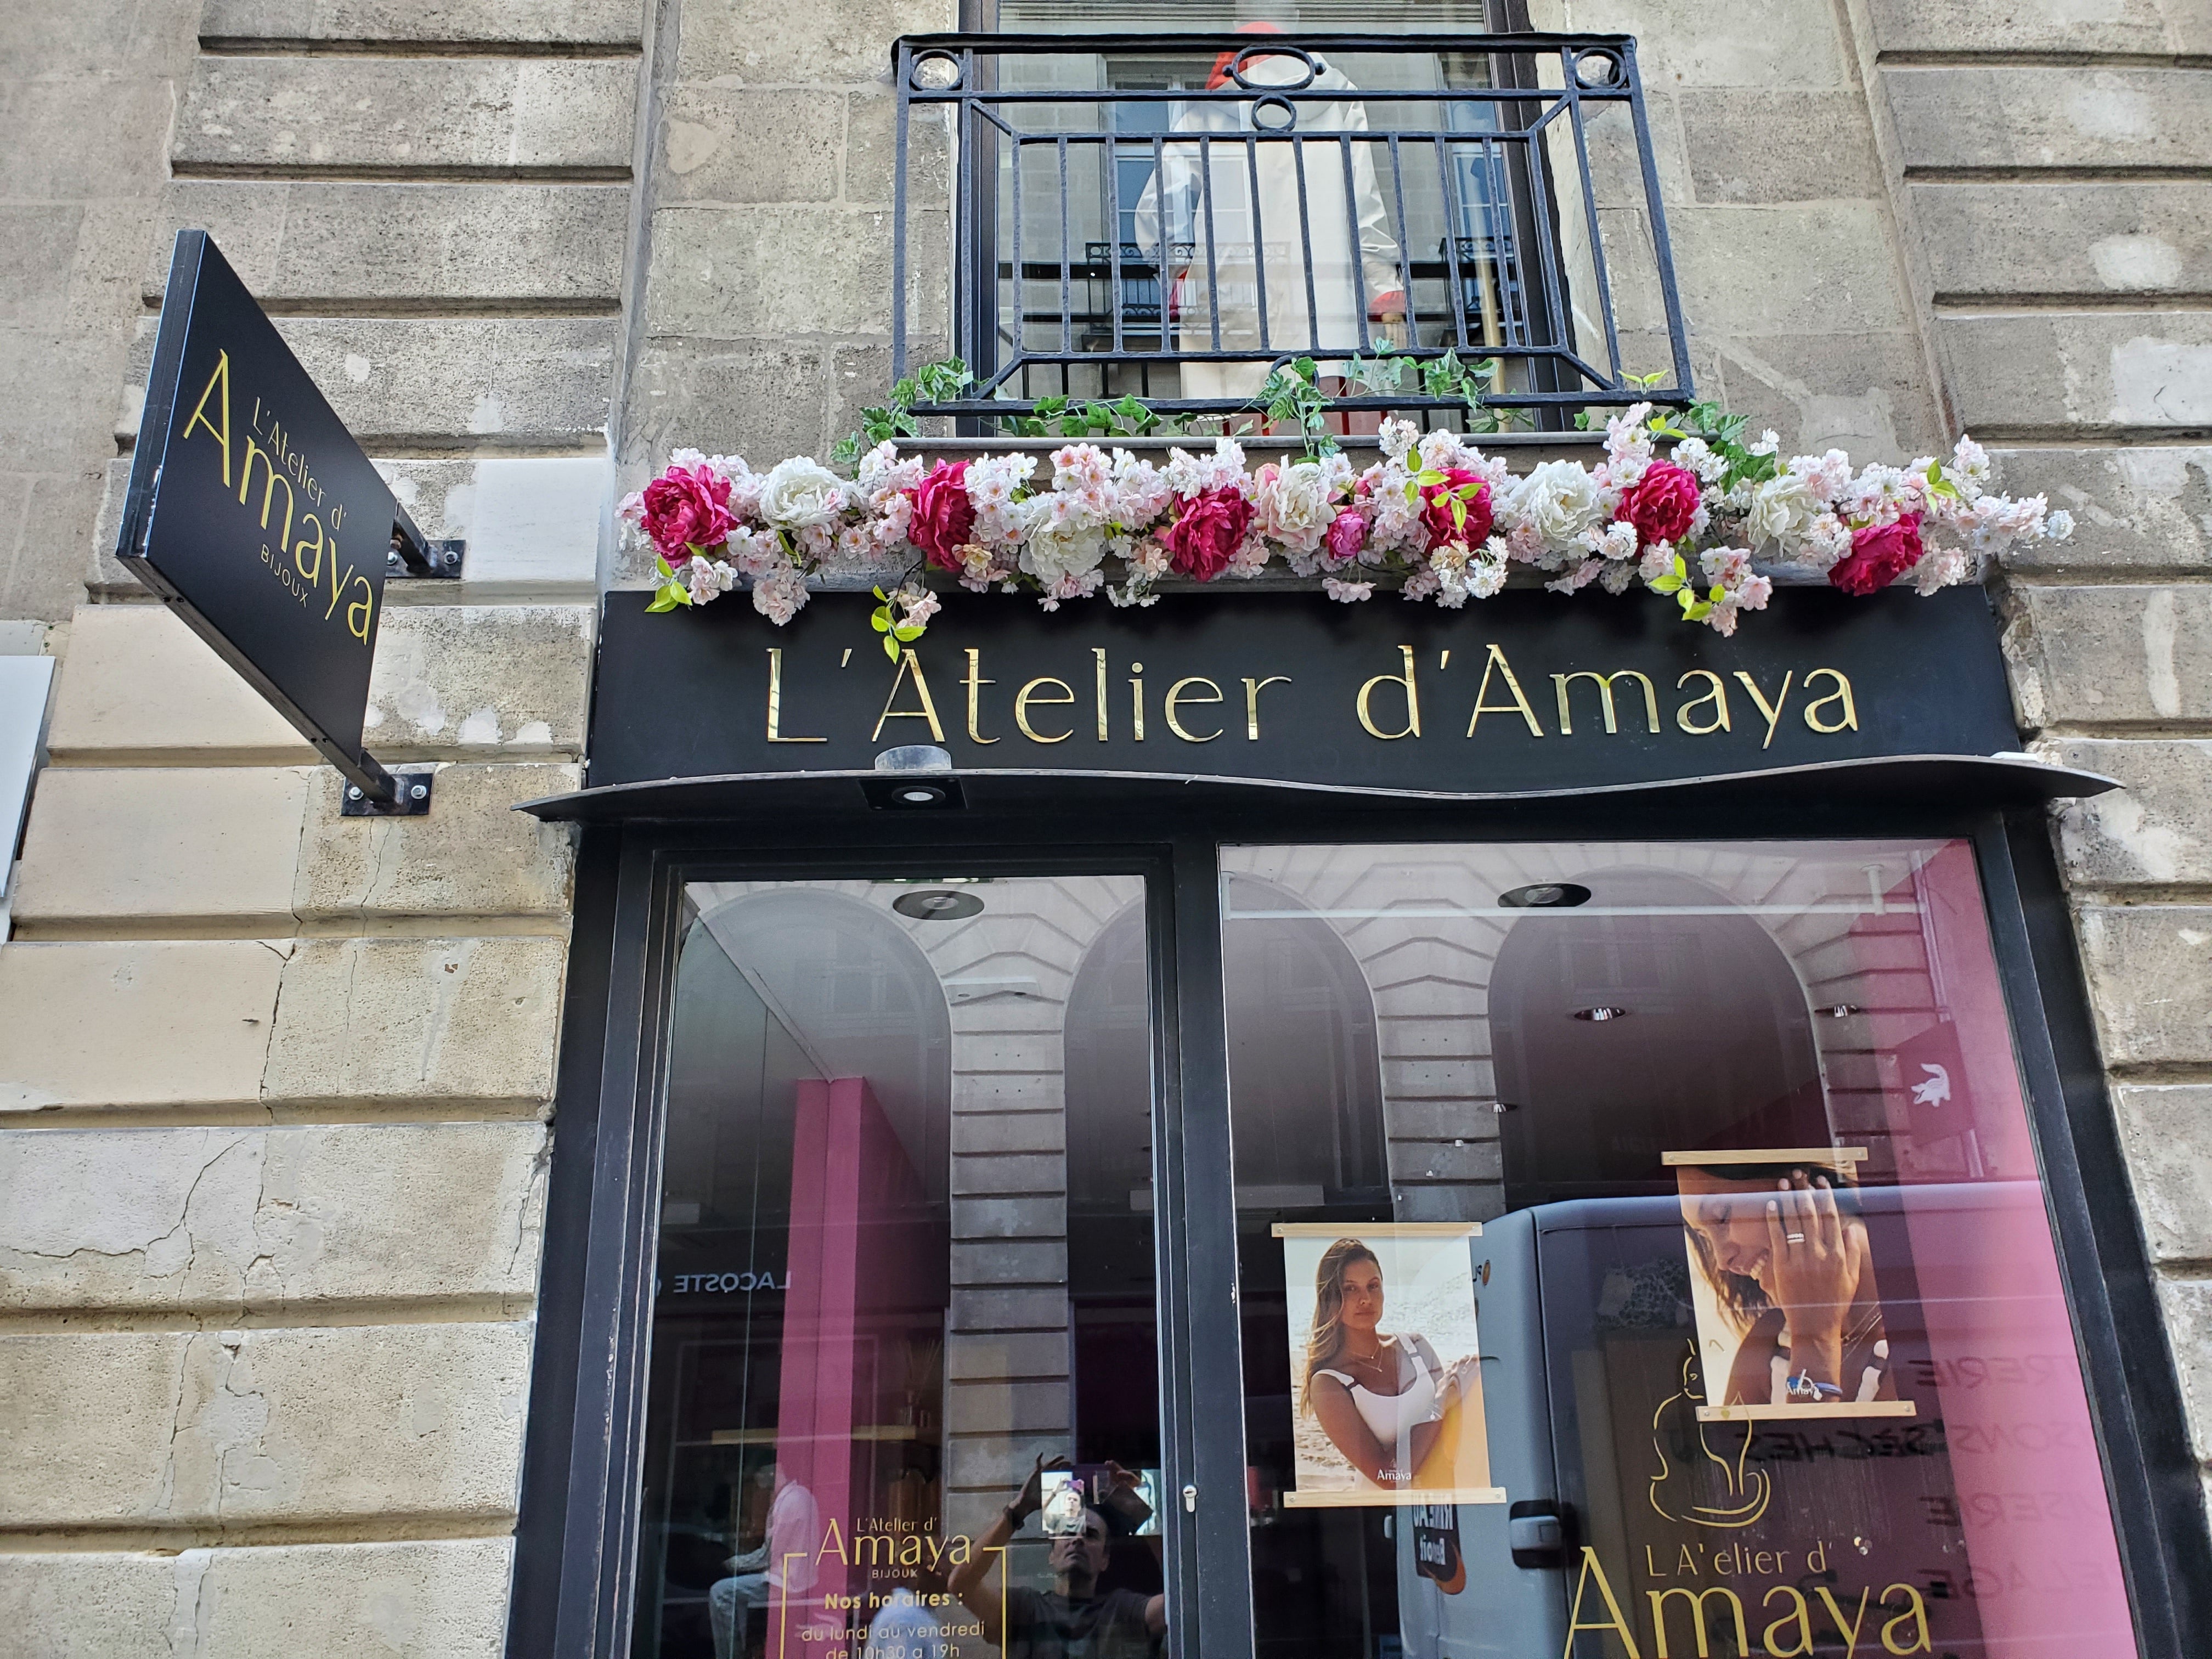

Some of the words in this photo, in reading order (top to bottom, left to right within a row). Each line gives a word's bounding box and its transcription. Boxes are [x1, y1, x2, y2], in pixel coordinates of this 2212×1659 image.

[253, 397, 326, 507] L'Atelier
[331, 505, 347, 532] d'
[183, 348, 373, 646] Amaya
[261, 544, 308, 607] BIJOUX
[766, 648, 1292, 743] L'Atelier
[1356, 644, 1858, 749] d'Amaya
[1786, 1381, 1817, 1397] Amay
[1377, 1469, 1412, 1481] Amaya
[815, 1518, 970, 1572] Amaya
[825, 1593, 861, 1609] Nos
[870, 1590, 950, 1609] horaires
[1564, 1546, 1932, 1659] Amaya
[802, 1626, 823, 1641] du
[831, 1624, 871, 1640] lundi
[878, 1627, 901, 1640] au
[909, 1620, 985, 1637] vendredi
[826, 1647, 849, 1659] de
[932, 1643, 960, 1658] 19h
